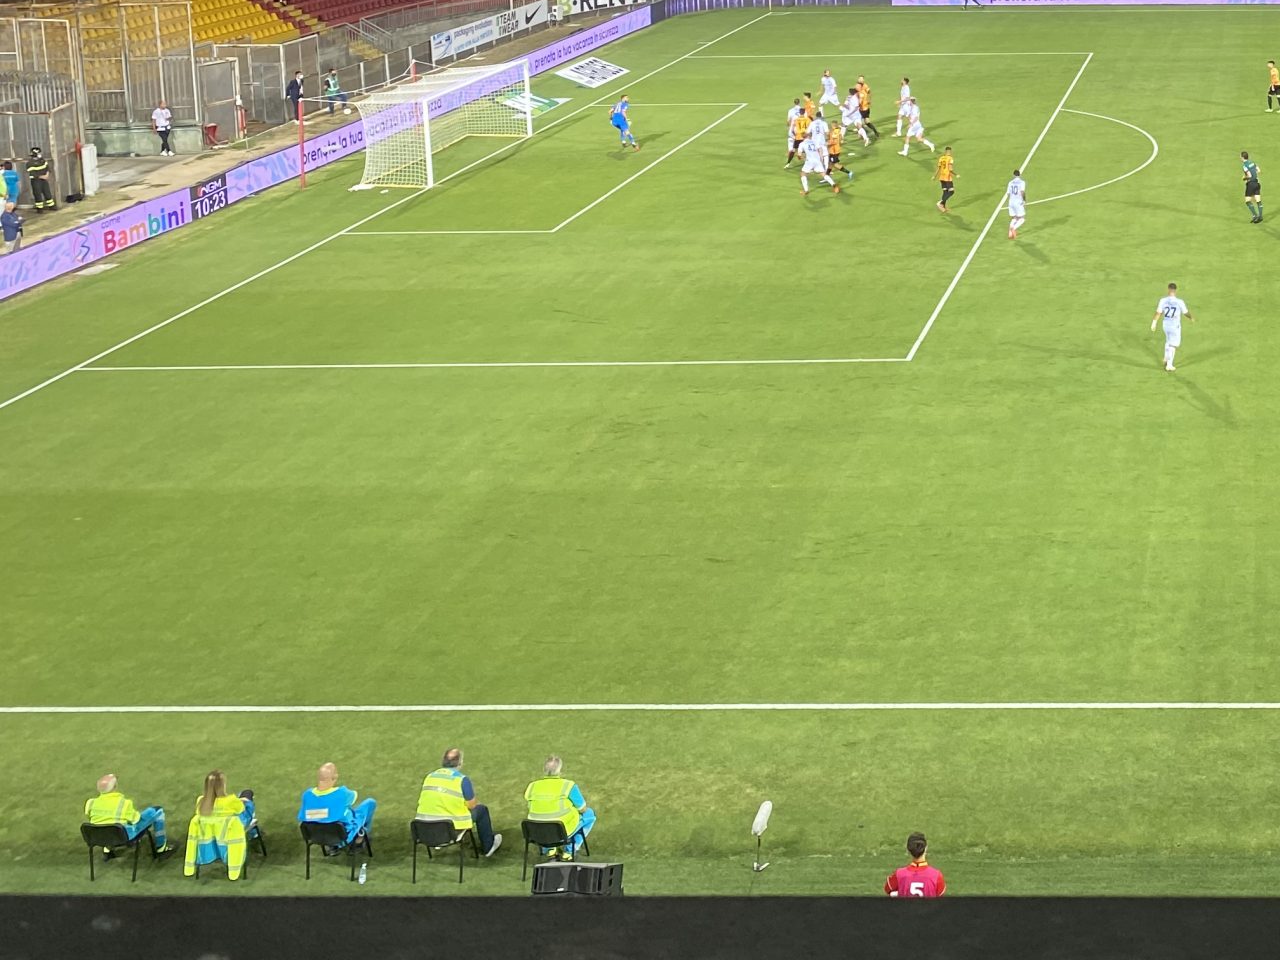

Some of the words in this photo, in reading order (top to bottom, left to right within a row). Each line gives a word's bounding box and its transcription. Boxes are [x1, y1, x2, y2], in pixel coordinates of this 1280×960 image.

[500, 10, 517, 25] TEAM
[534, 51, 556, 71] prenota
[573, 36, 594, 52] vacanza
[599, 25, 619, 40] sicurezza
[349, 131, 363, 145] tua
[200, 177, 222, 197] NGM
[1010, 185, 1019, 196] 10
[195, 190, 226, 218] 10:23
[100, 215, 121, 230] come
[103, 201, 186, 254] Bambini
[1164, 306, 1177, 319] 27
[909, 881, 925, 897] 5
